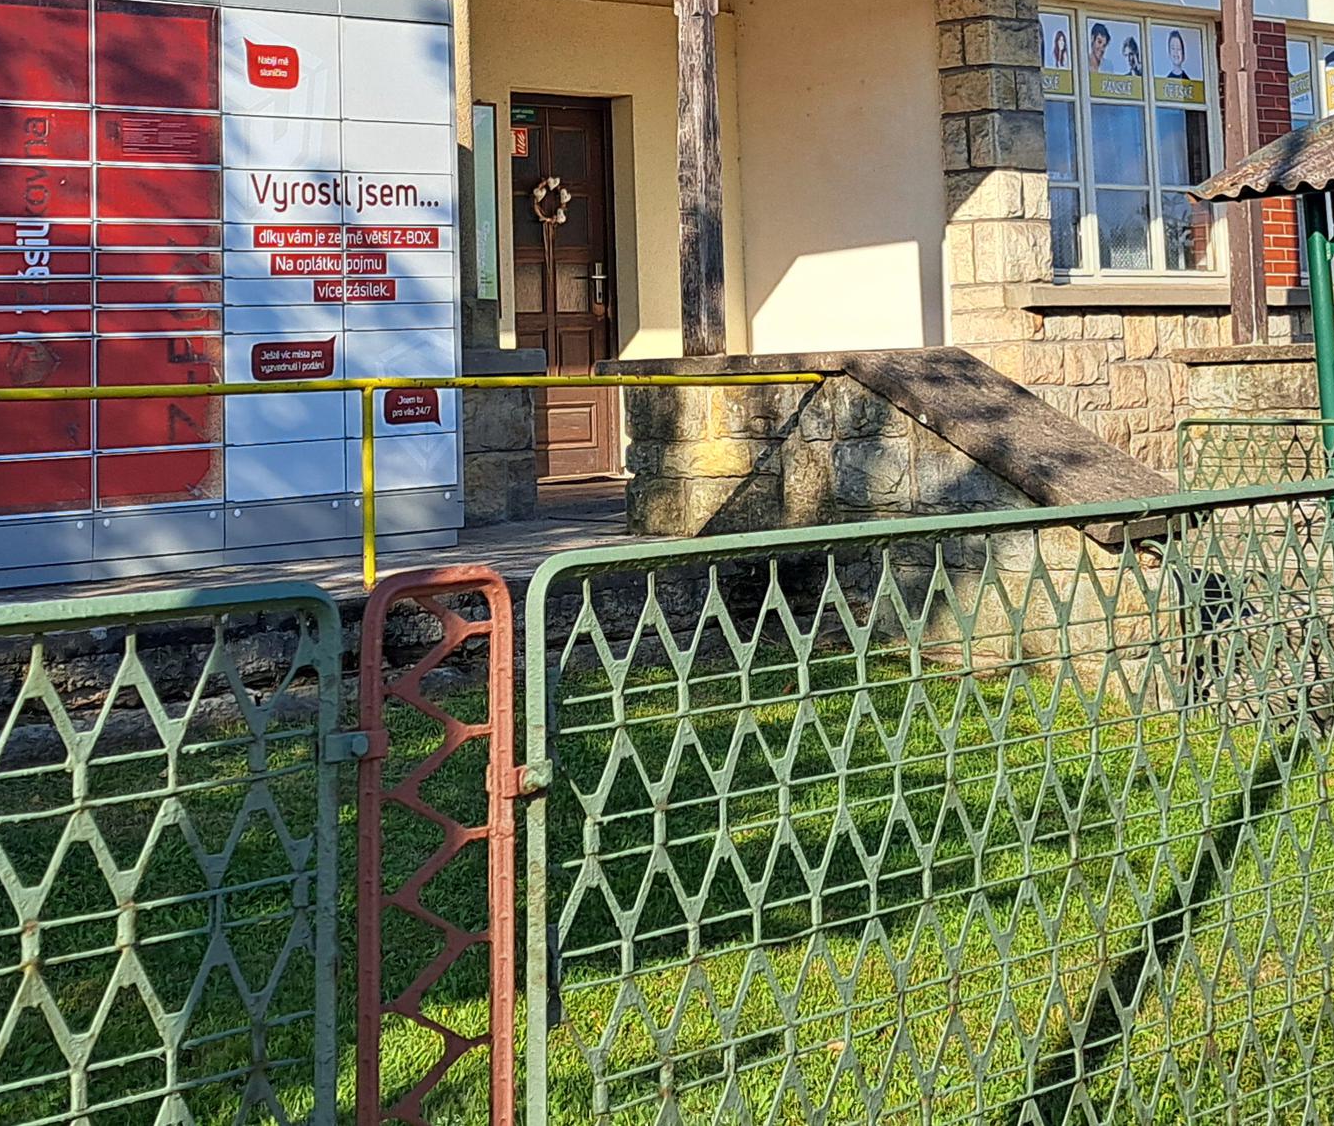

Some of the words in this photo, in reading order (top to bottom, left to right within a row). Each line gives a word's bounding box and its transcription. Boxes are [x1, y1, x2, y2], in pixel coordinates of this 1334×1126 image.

[251, 174, 352, 213] Vyrostl
[356, 176, 440, 213] jsem...
[258, 230, 285, 247] díky
[287, 229, 313, 244] vám
[314, 231, 326, 247] je
[364, 229, 392, 245] větší
[393, 230, 435, 245] Z-BOX.
[275, 256, 294, 271] Na
[296, 255, 342, 274] oplátku
[345, 258, 383, 274] pojmu
[317, 284, 342, 298] více
[346, 282, 391, 298] zásilek.
